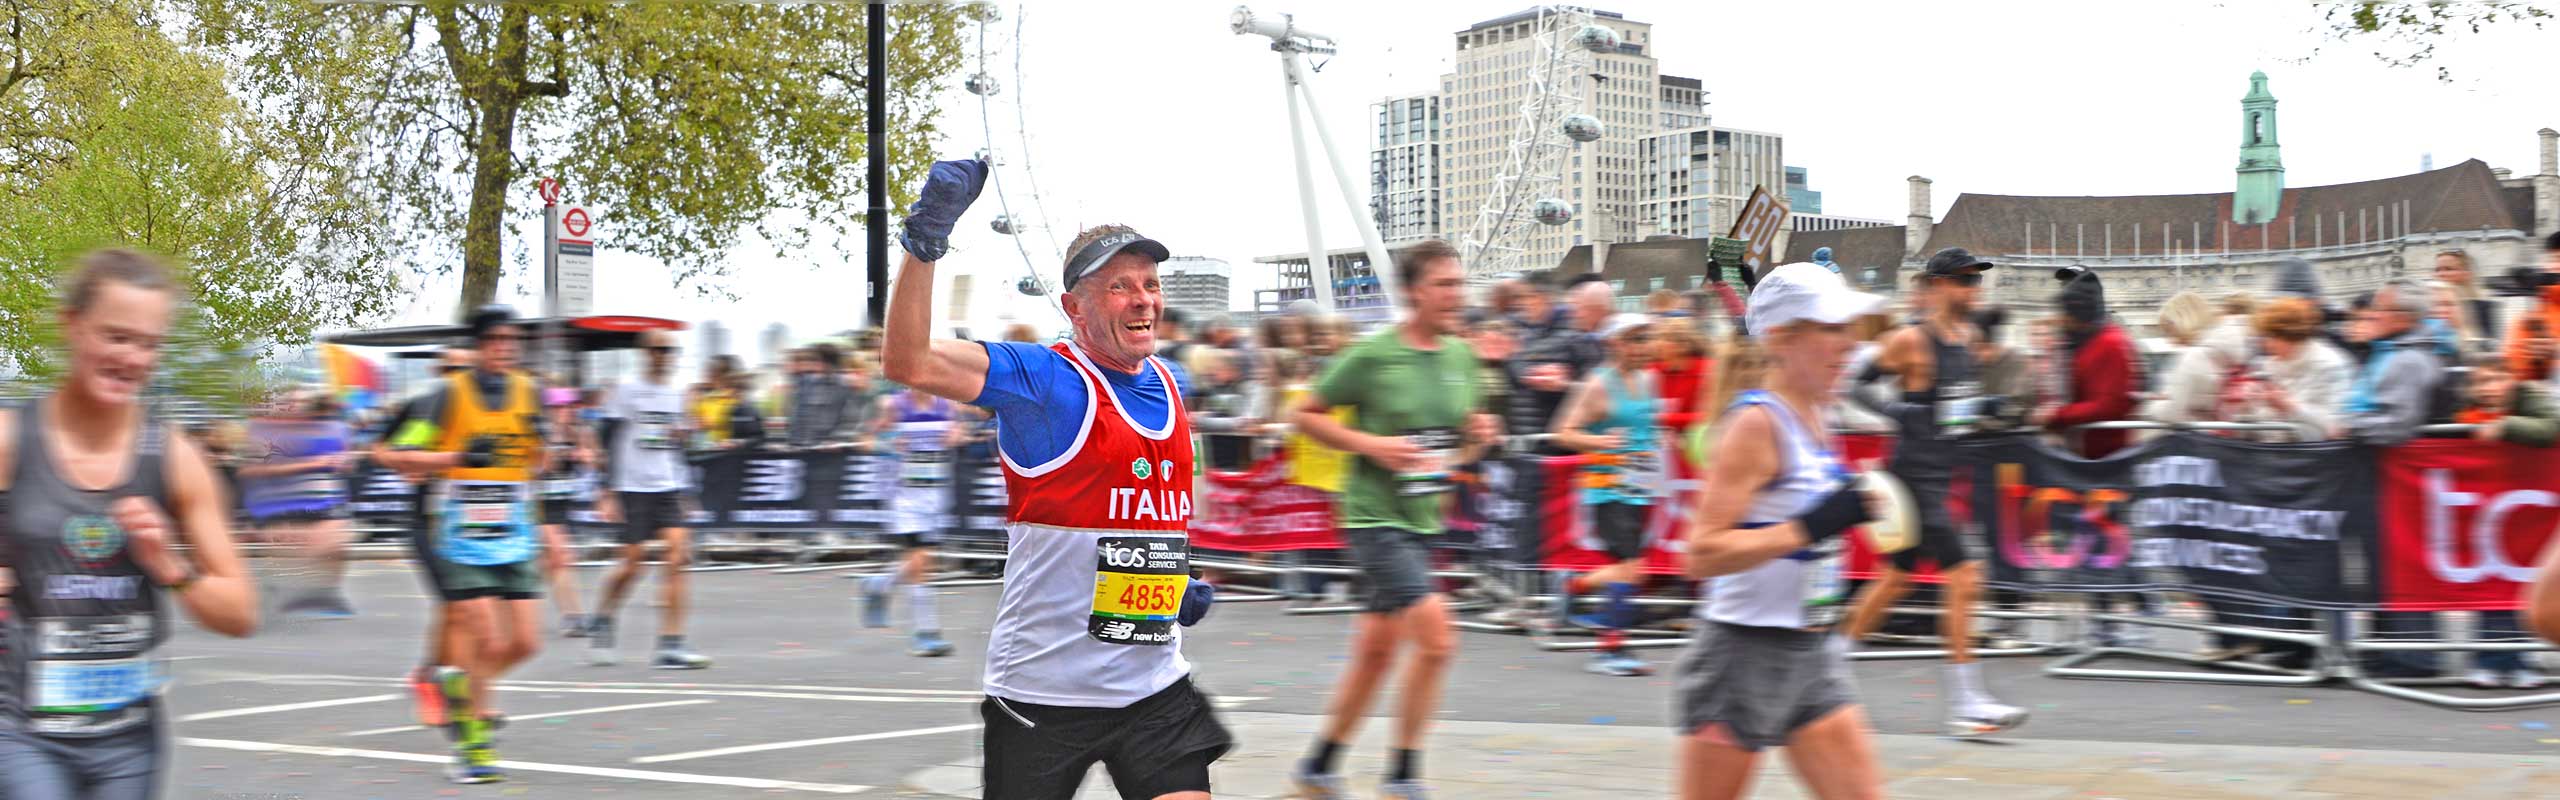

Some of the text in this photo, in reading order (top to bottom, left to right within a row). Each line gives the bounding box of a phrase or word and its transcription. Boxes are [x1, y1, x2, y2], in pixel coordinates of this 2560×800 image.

[544, 181, 556, 200] K
[1738, 193, 1783, 255] GO
[1108, 487, 1191, 521] ITALIA
[1105, 541, 1146, 568] tcs
[1148, 542, 1169, 551] TATA
[1147, 560, 1177, 568] SERVICES
[1119, 583, 1175, 611] 4853
[1133, 632, 1153, 641] new
